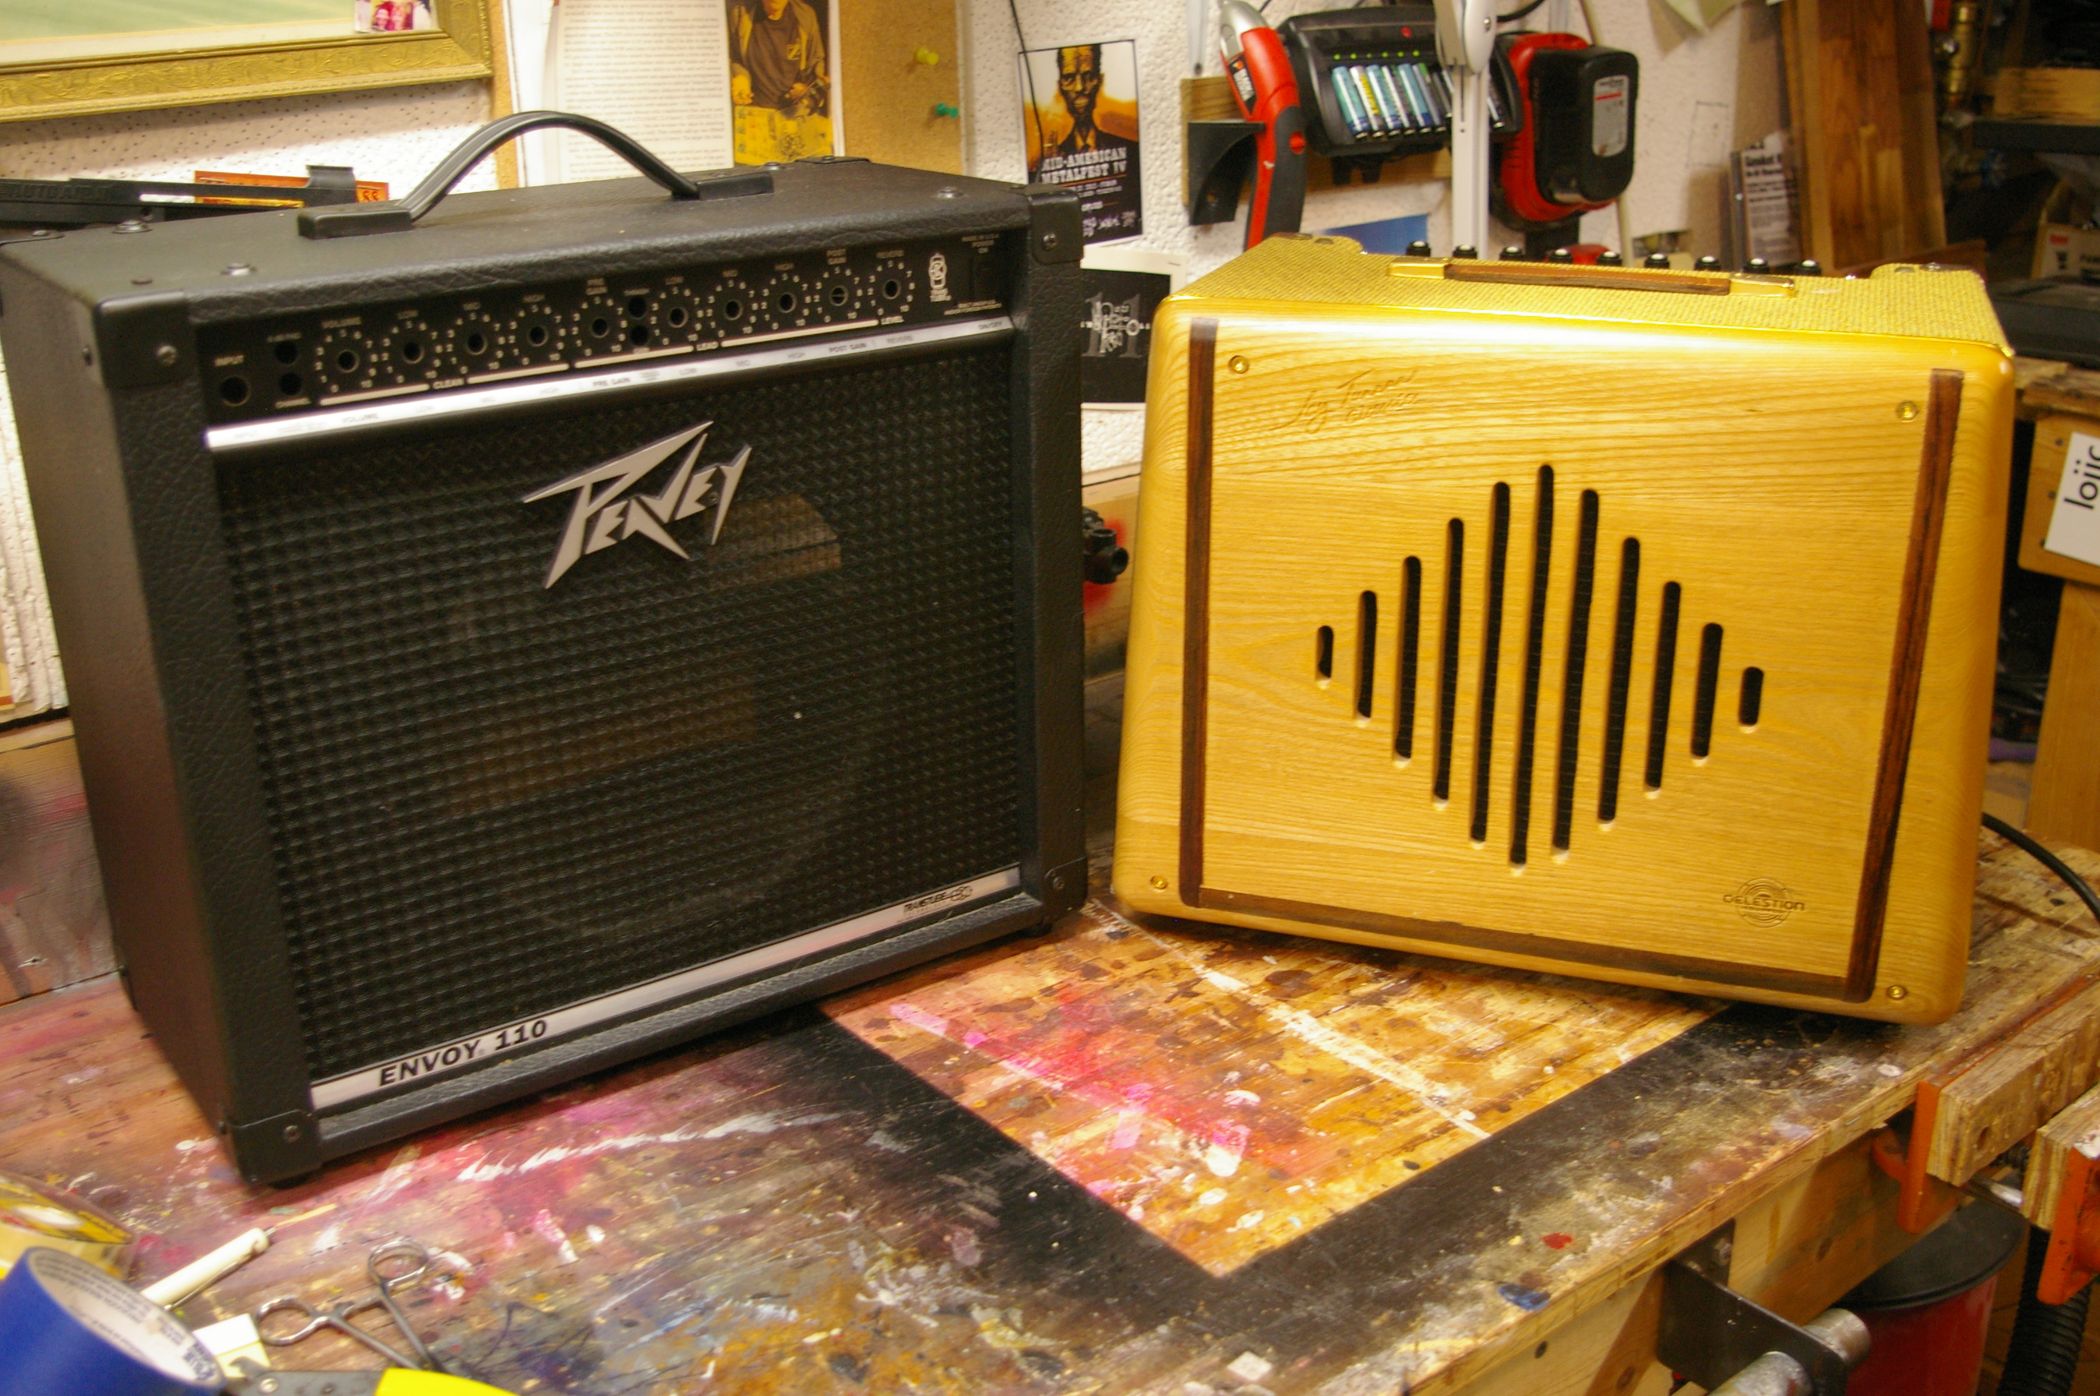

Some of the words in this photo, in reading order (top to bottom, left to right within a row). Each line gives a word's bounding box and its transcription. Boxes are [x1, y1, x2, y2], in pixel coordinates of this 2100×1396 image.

[1041, 163, 1110, 185] METALFEST
[522, 419, 753, 590] PEAVEY
[379, 1039, 480, 1087] ENVOY
[494, 1019, 548, 1051] 110
